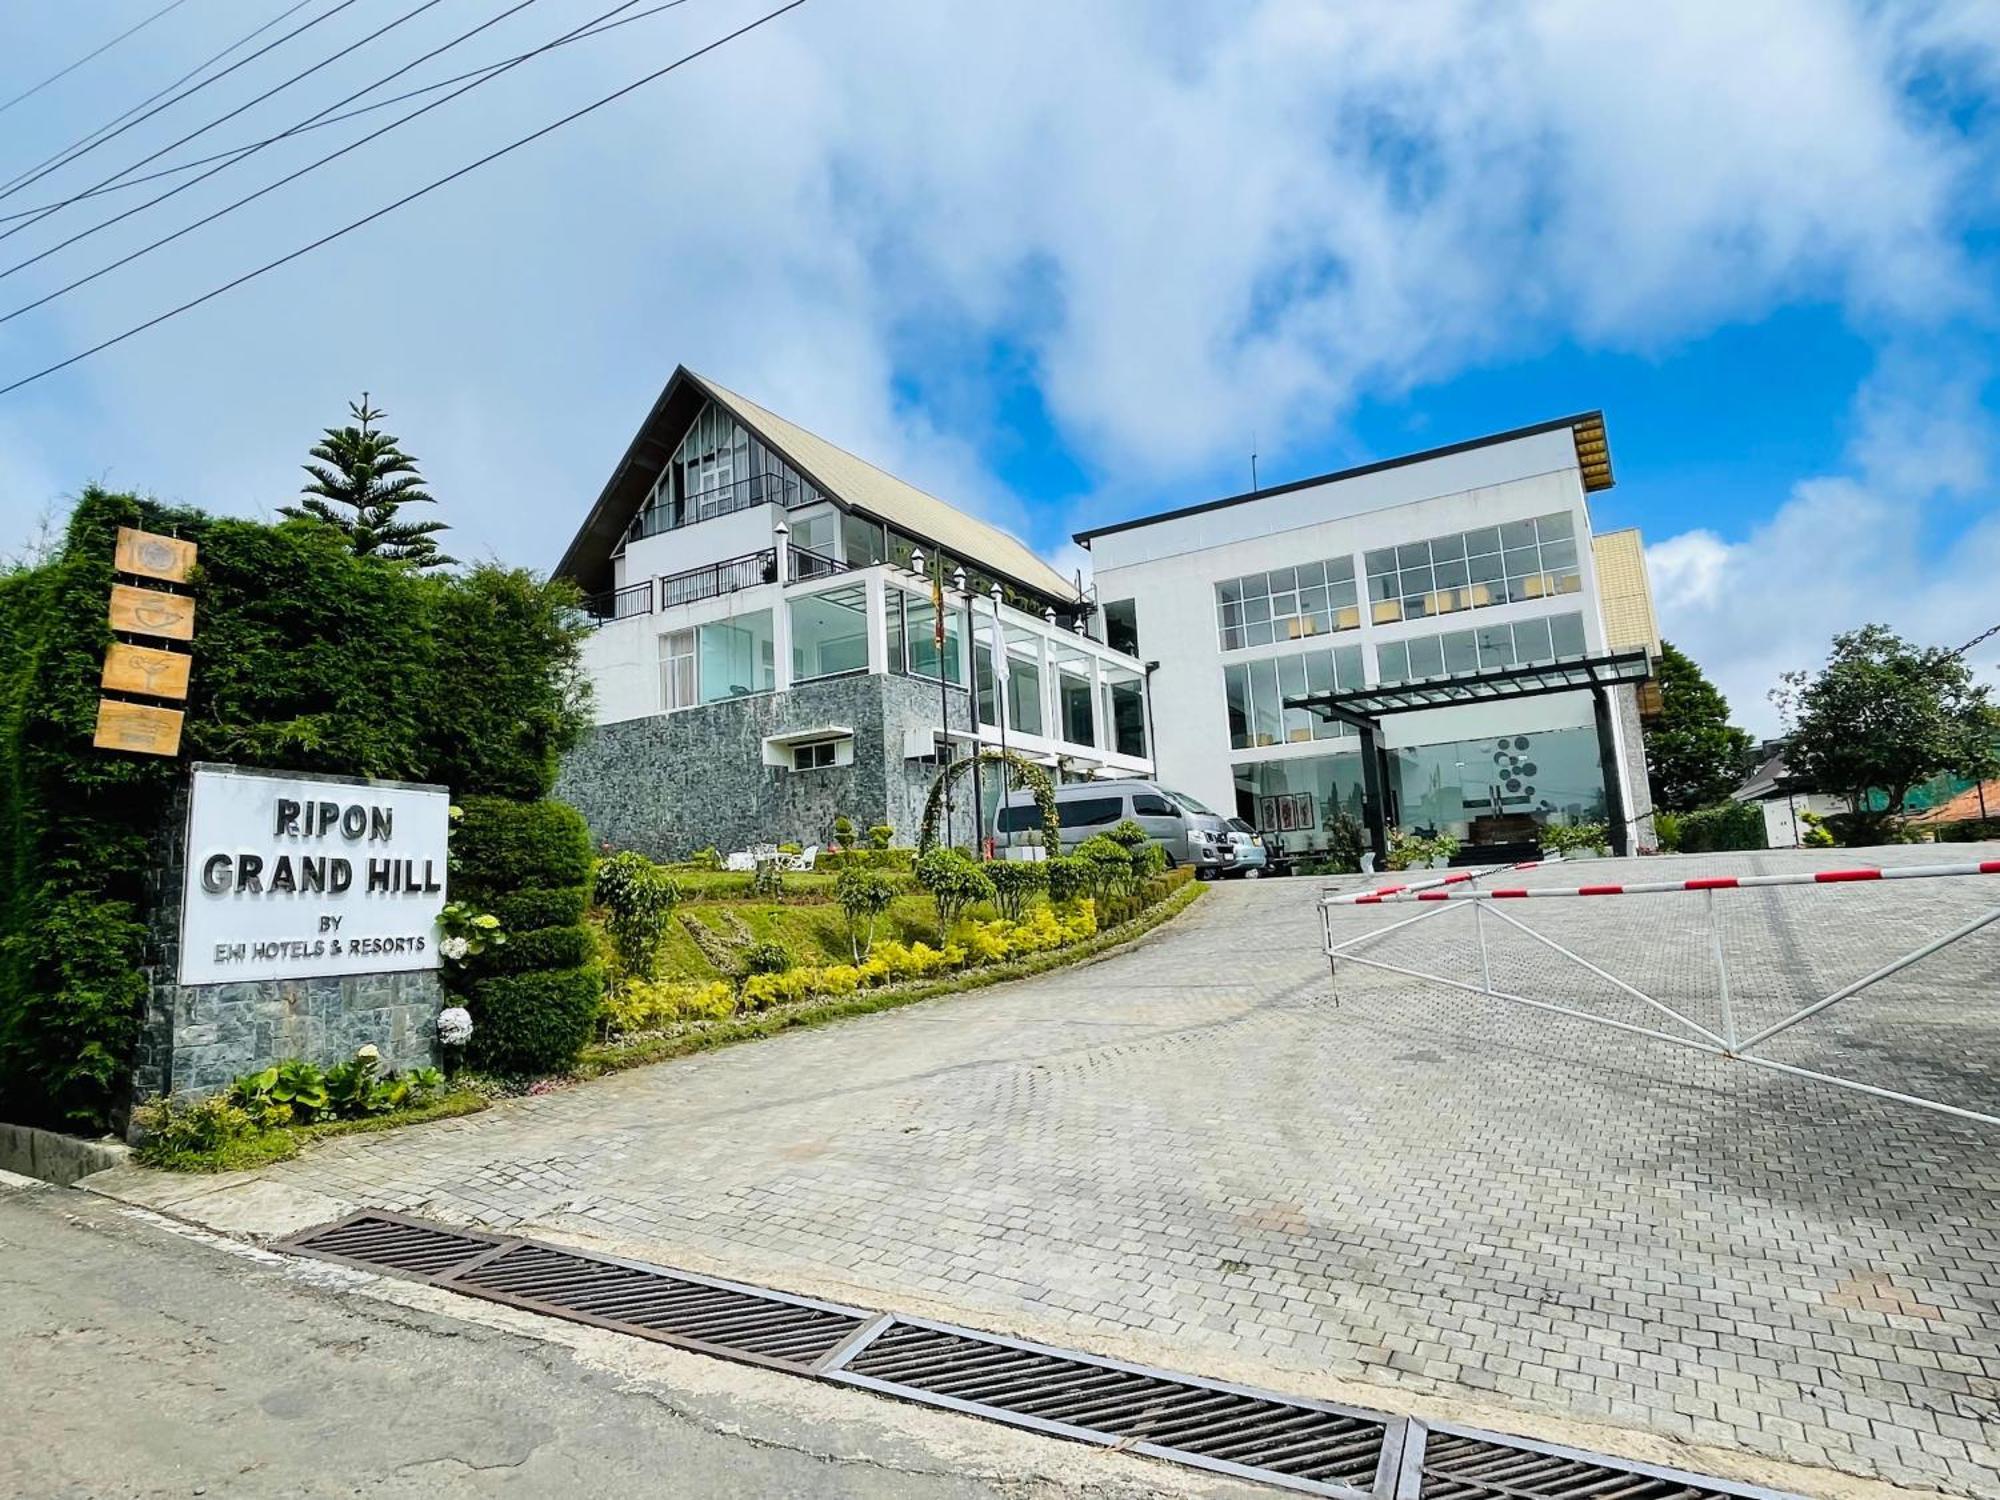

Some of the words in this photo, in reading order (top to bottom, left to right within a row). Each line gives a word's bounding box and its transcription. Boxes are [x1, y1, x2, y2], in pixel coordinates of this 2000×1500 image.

[274, 798, 393, 841] RIPON
[201, 854, 353, 894] GRAND
[366, 858, 441, 893] HILL
[319, 915, 342, 933] BY
[252, 940, 325, 961] HOTELS
[330, 939, 342, 955] &
[348, 936, 425, 955] RESORTS
